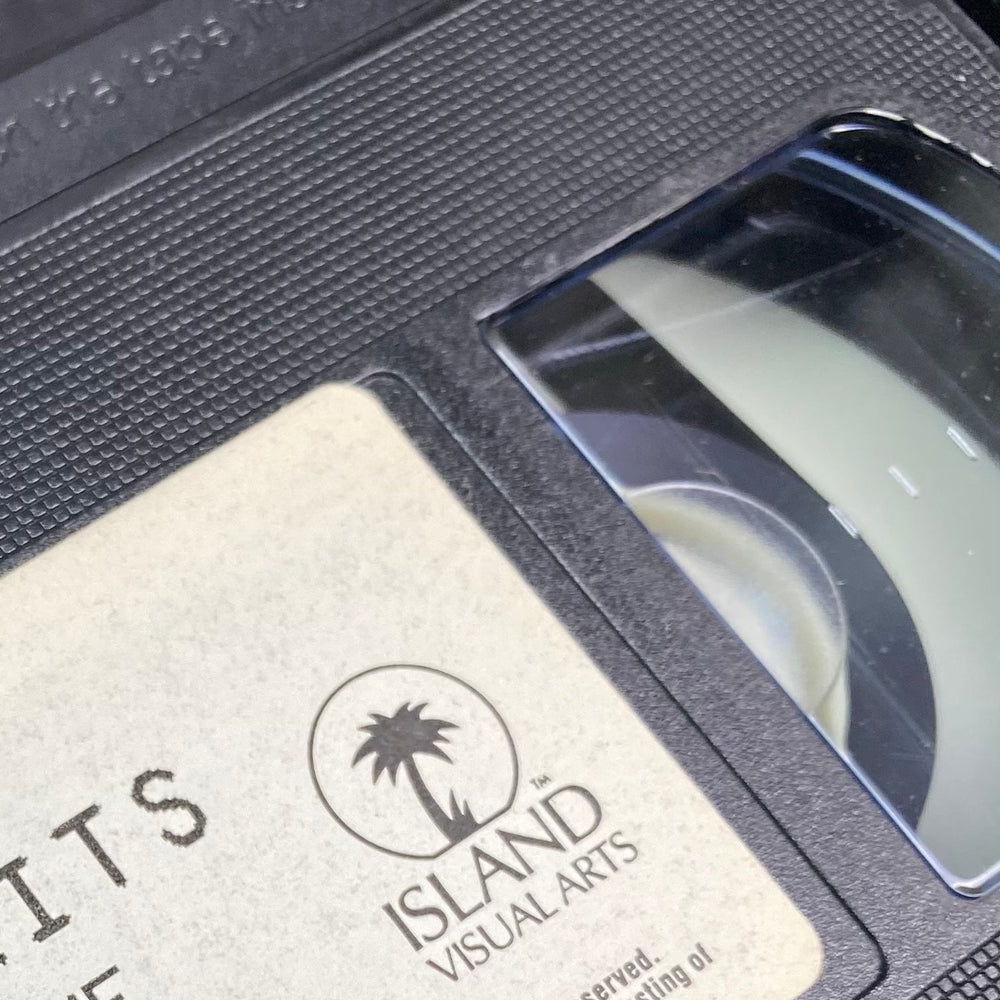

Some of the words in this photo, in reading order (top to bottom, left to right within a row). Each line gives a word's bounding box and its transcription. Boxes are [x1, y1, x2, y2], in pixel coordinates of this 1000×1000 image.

[381, 784, 603, 952] ISLAND
[425, 892, 560, 982] VISUAL
[556, 831, 639, 906] ARTS
[688, 942, 714, 972] of
